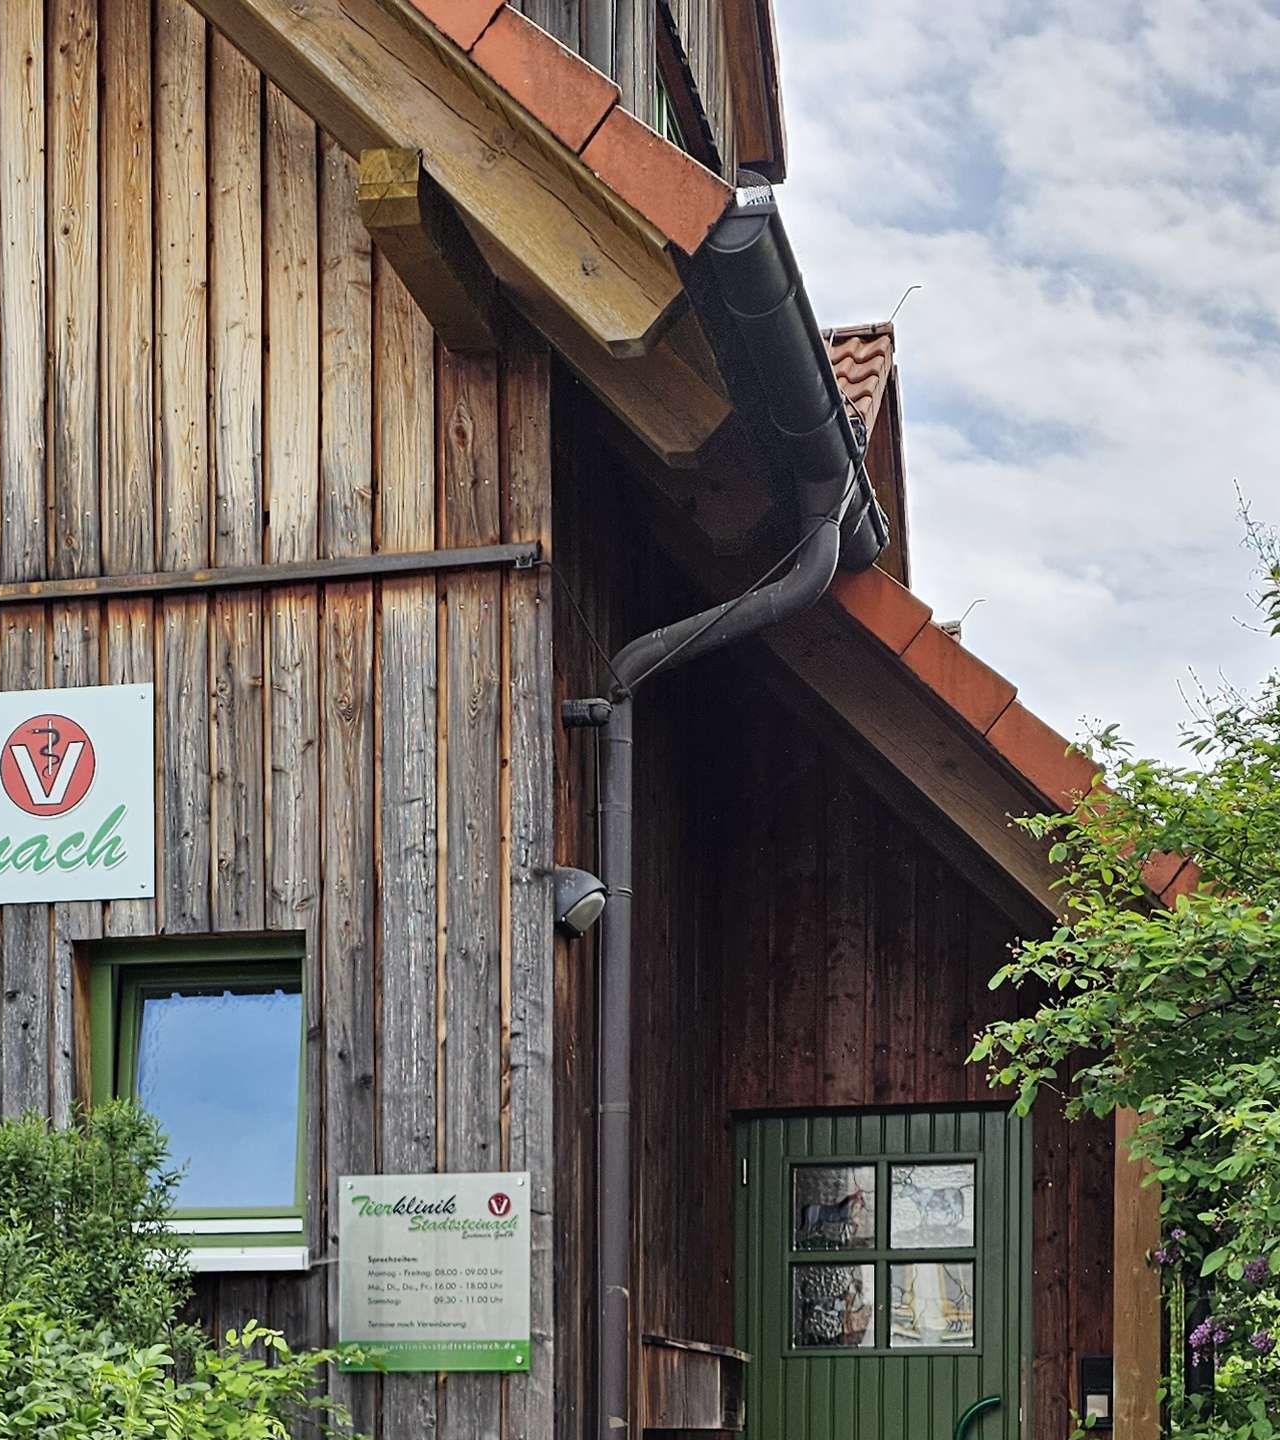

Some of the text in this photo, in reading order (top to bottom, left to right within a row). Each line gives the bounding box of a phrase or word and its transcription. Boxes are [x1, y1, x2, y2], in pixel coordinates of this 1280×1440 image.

[351, 1194, 457, 1217] Tierklinik
[408, 1214, 519, 1233] Stadtsteinach
[434, 1268, 458, 1277] 08.00
[465, 1268, 488, 1276] 09.00
[490, 1268, 503, 1276] Uhr
[434, 1282, 457, 1290] 16.00
[466, 1282, 488, 1290] 18.00
[490, 1282, 503, 1290] Uhr
[433, 1296, 457, 1305] 09.30
[466, 1296, 488, 1304] 11.00
[490, 1296, 504, 1304] Uhr
